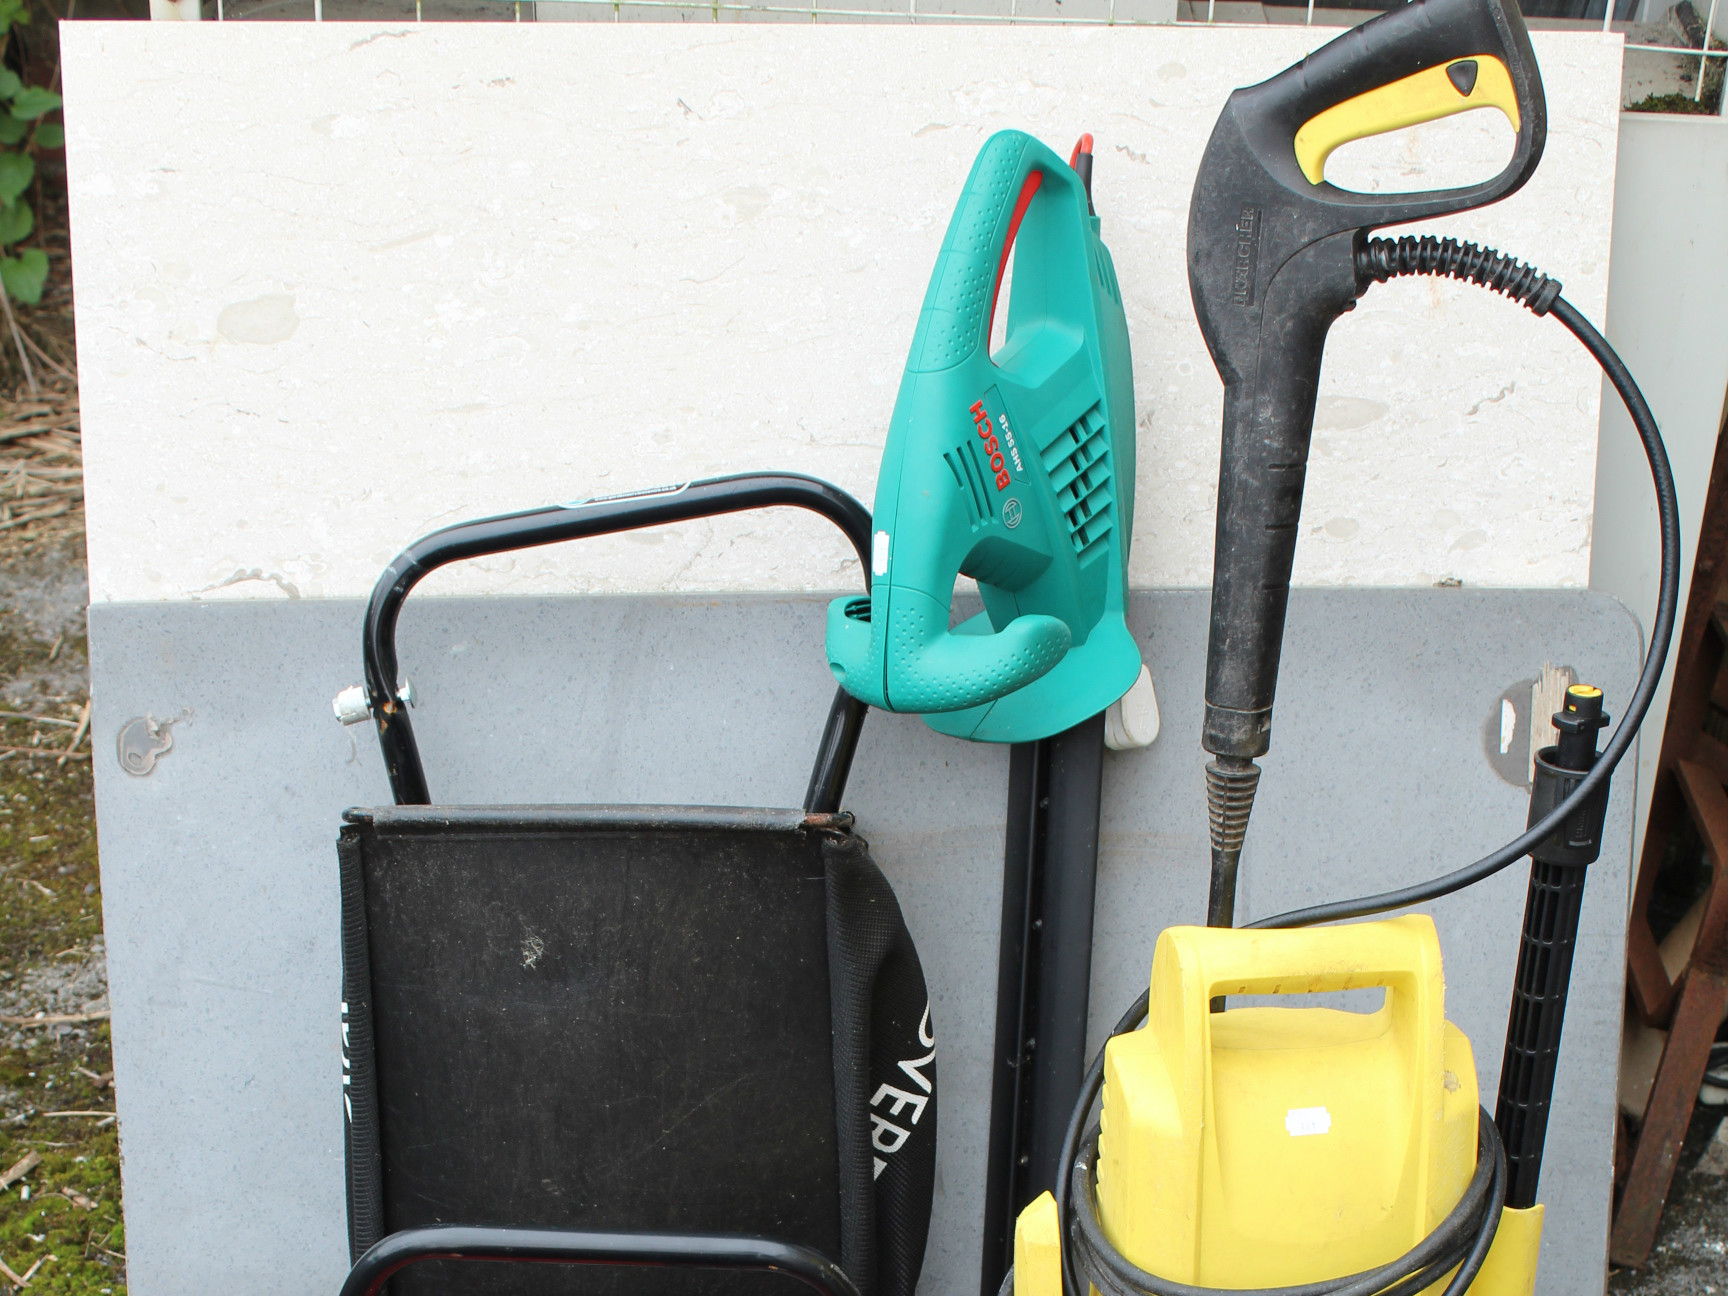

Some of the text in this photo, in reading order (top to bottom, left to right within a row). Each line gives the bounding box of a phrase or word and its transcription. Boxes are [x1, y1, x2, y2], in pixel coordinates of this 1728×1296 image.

[969, 399, 1011, 491] BOSCH
[999, 414, 1023, 472] AHS 55-16
